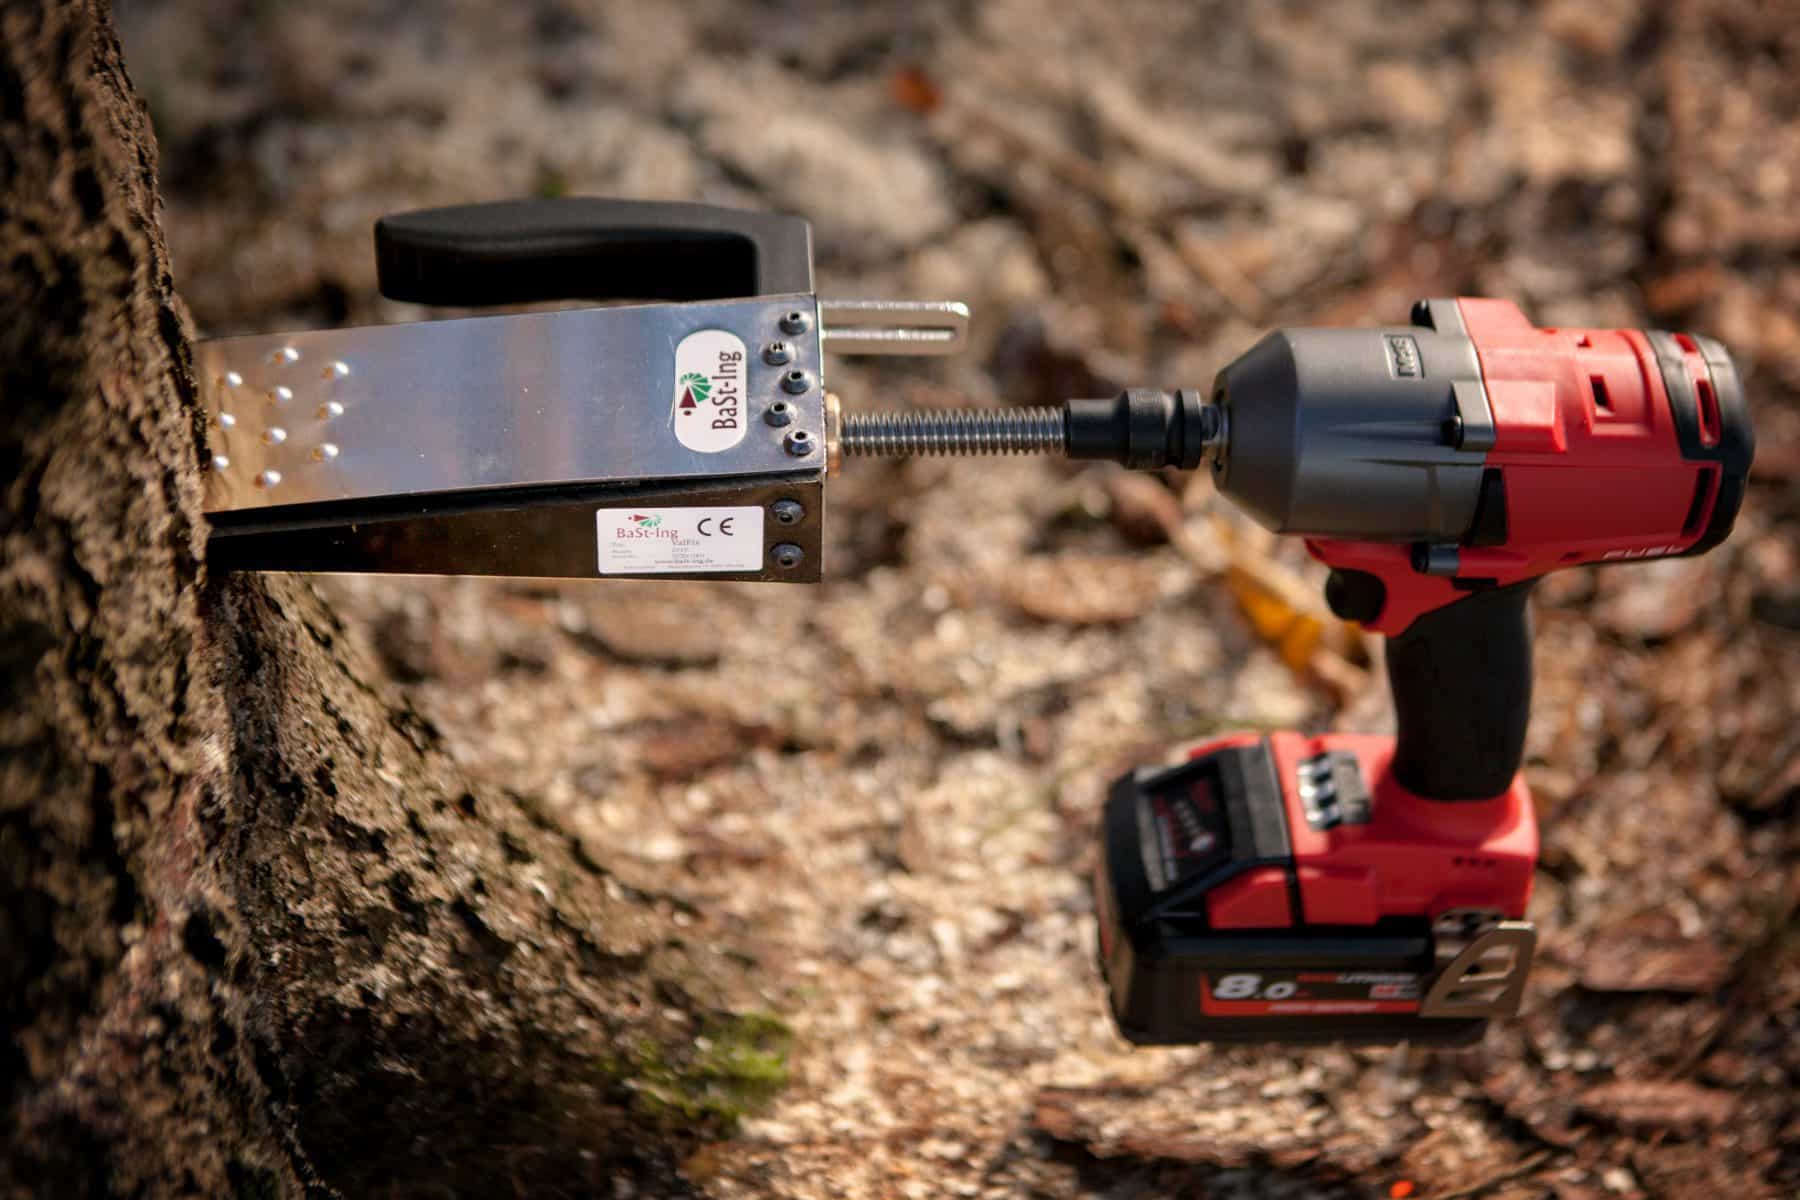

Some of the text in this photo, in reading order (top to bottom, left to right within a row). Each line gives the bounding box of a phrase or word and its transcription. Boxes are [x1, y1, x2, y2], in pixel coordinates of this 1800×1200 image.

[711, 351, 742, 430] BaSt-Ing
[616, 527, 679, 541] BaSt-Ing
[697, 517, 734, 537] CE
